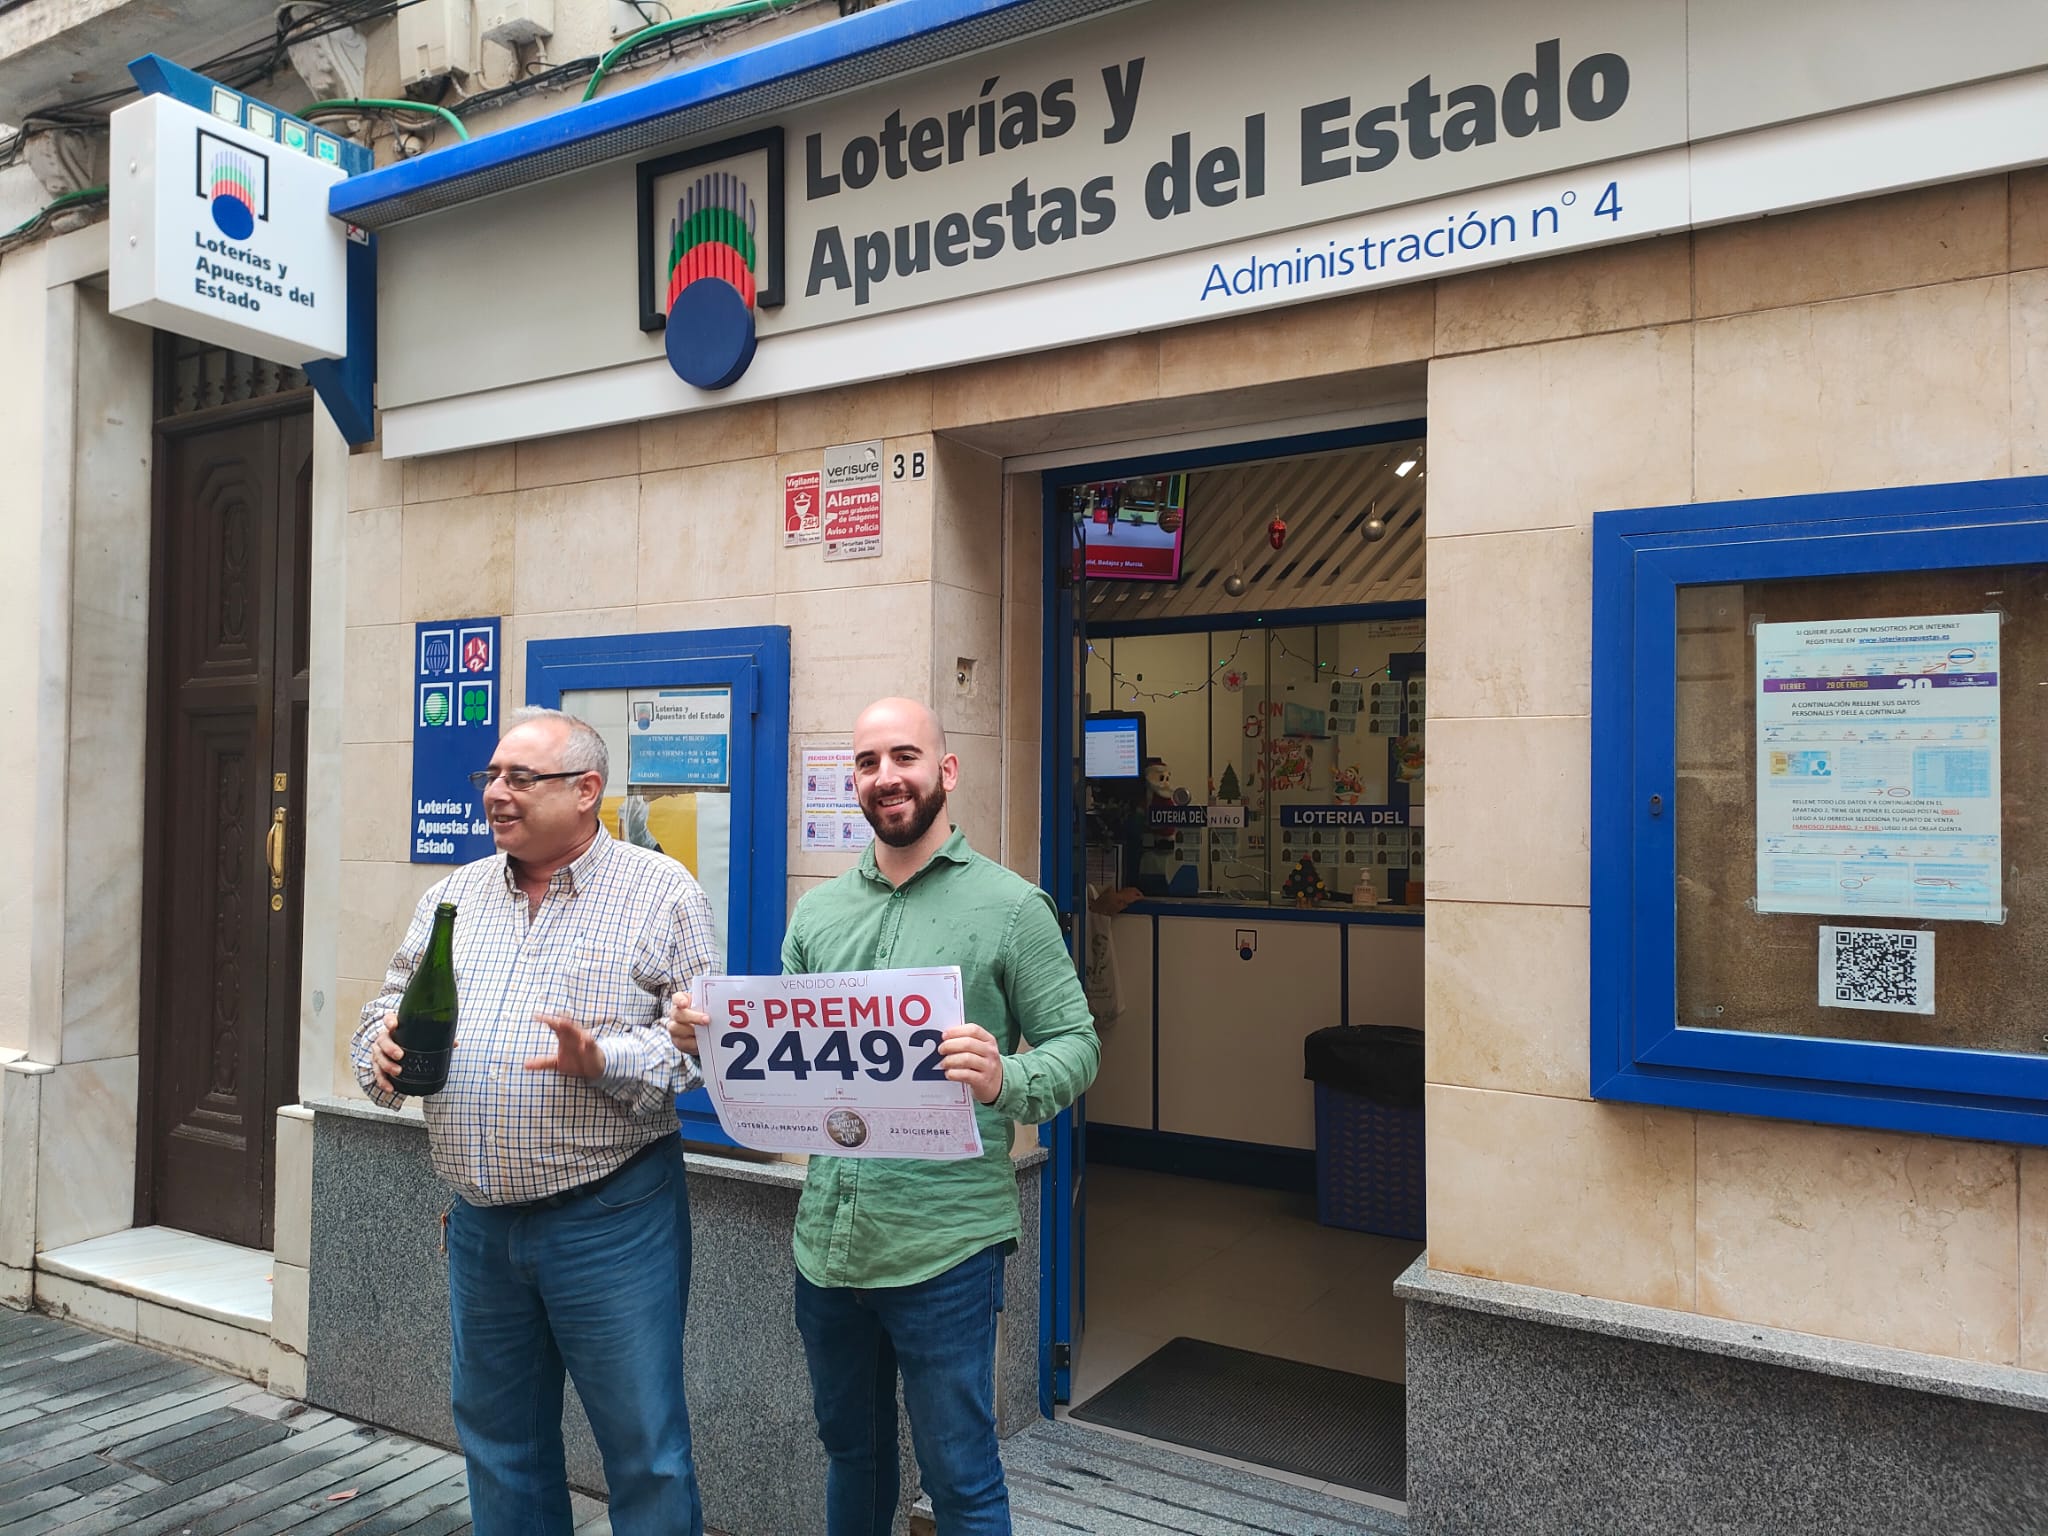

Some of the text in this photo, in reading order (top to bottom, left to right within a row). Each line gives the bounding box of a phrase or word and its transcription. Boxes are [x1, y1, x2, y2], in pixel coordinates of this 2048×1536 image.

[806, 57, 1146, 201] Loterías y
[804, 38, 1631, 306] Apuestas del Estado
[1201, 210, 1516, 301] Administración
[1593, 182, 1623, 222] 4
[195, 231, 288, 280] Loterías y
[196, 255, 315, 308] Apuestas del
[195, 277, 261, 312] Estado
[827, 461, 880, 477] verisure
[893, 452, 925, 479] 3 B
[786, 476, 819, 489] Vigilante
[826, 492, 879, 508] Alarma
[802, 516, 818, 528] 24H
[838, 515, 848, 523] de
[826, 526, 847, 536] Aviso
[1803, 628, 1828, 636] QUIERE
[1829, 627, 1853, 635] JUGAR
[1869, 625, 1908, 633] NOSOTROS
[1925, 622, 1961, 630] INTERNET
[1846, 680, 1869, 689] ENERO
[1798, 700, 1851, 708] CONTINUACIÓN
[655, 711, 725, 721] Apuestas del Estado
[1791, 709, 1834, 717] PERSONALES
[417, 798, 472, 819] Loterías y
[1188, 810, 1206, 824] DEL
[1210, 814, 1241, 825] NIÑO
[1294, 810, 1404, 825] LOTERIA DEL
[417, 818, 490, 838] Apuestas del
[416, 838, 455, 854] Estado
[780, 974, 870, 991] VENDIDO AQUÍ
[764, 993, 932, 1029] PREMIO
[720, 1029, 950, 1082] 24492
[780, 1124, 819, 1132] NAVIDAD
[903, 1127, 952, 1136] DICIEMBRE
